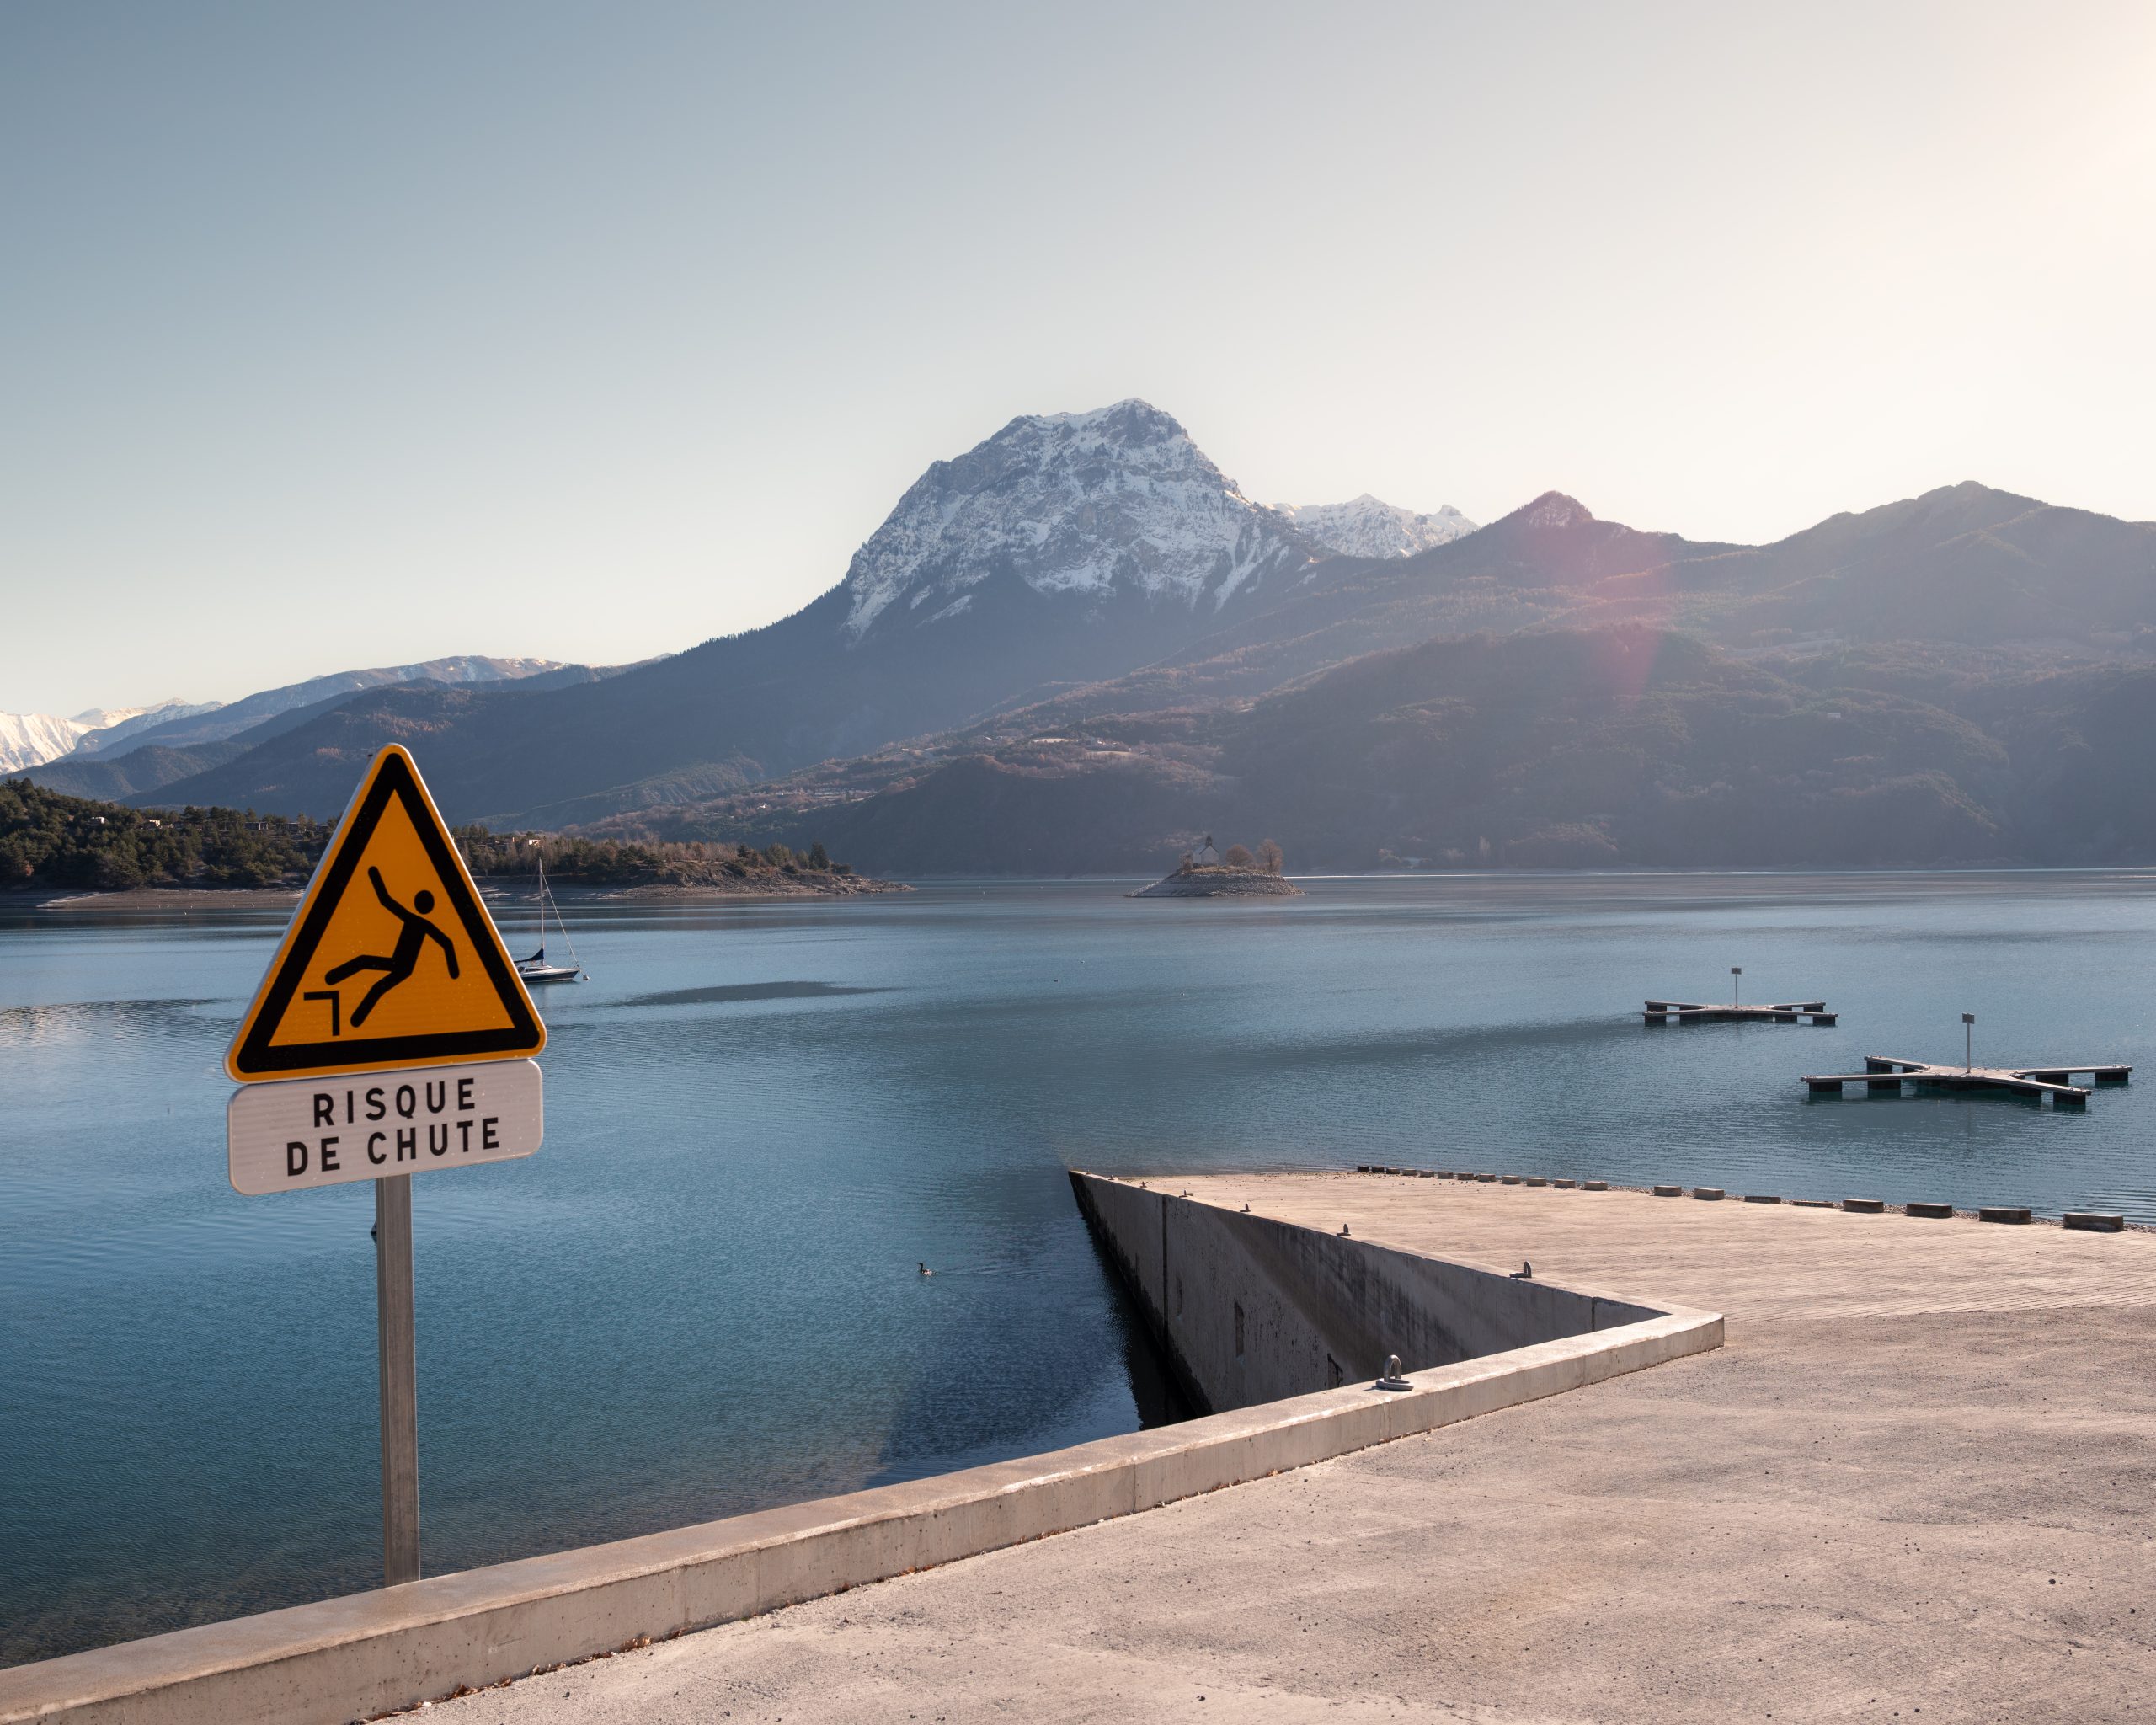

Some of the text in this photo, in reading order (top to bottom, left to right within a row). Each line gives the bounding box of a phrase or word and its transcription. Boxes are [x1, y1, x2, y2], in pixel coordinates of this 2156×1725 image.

[314, 1078, 475, 1127] RISQUE
[287, 1117, 499, 1176] DE CHUTE
